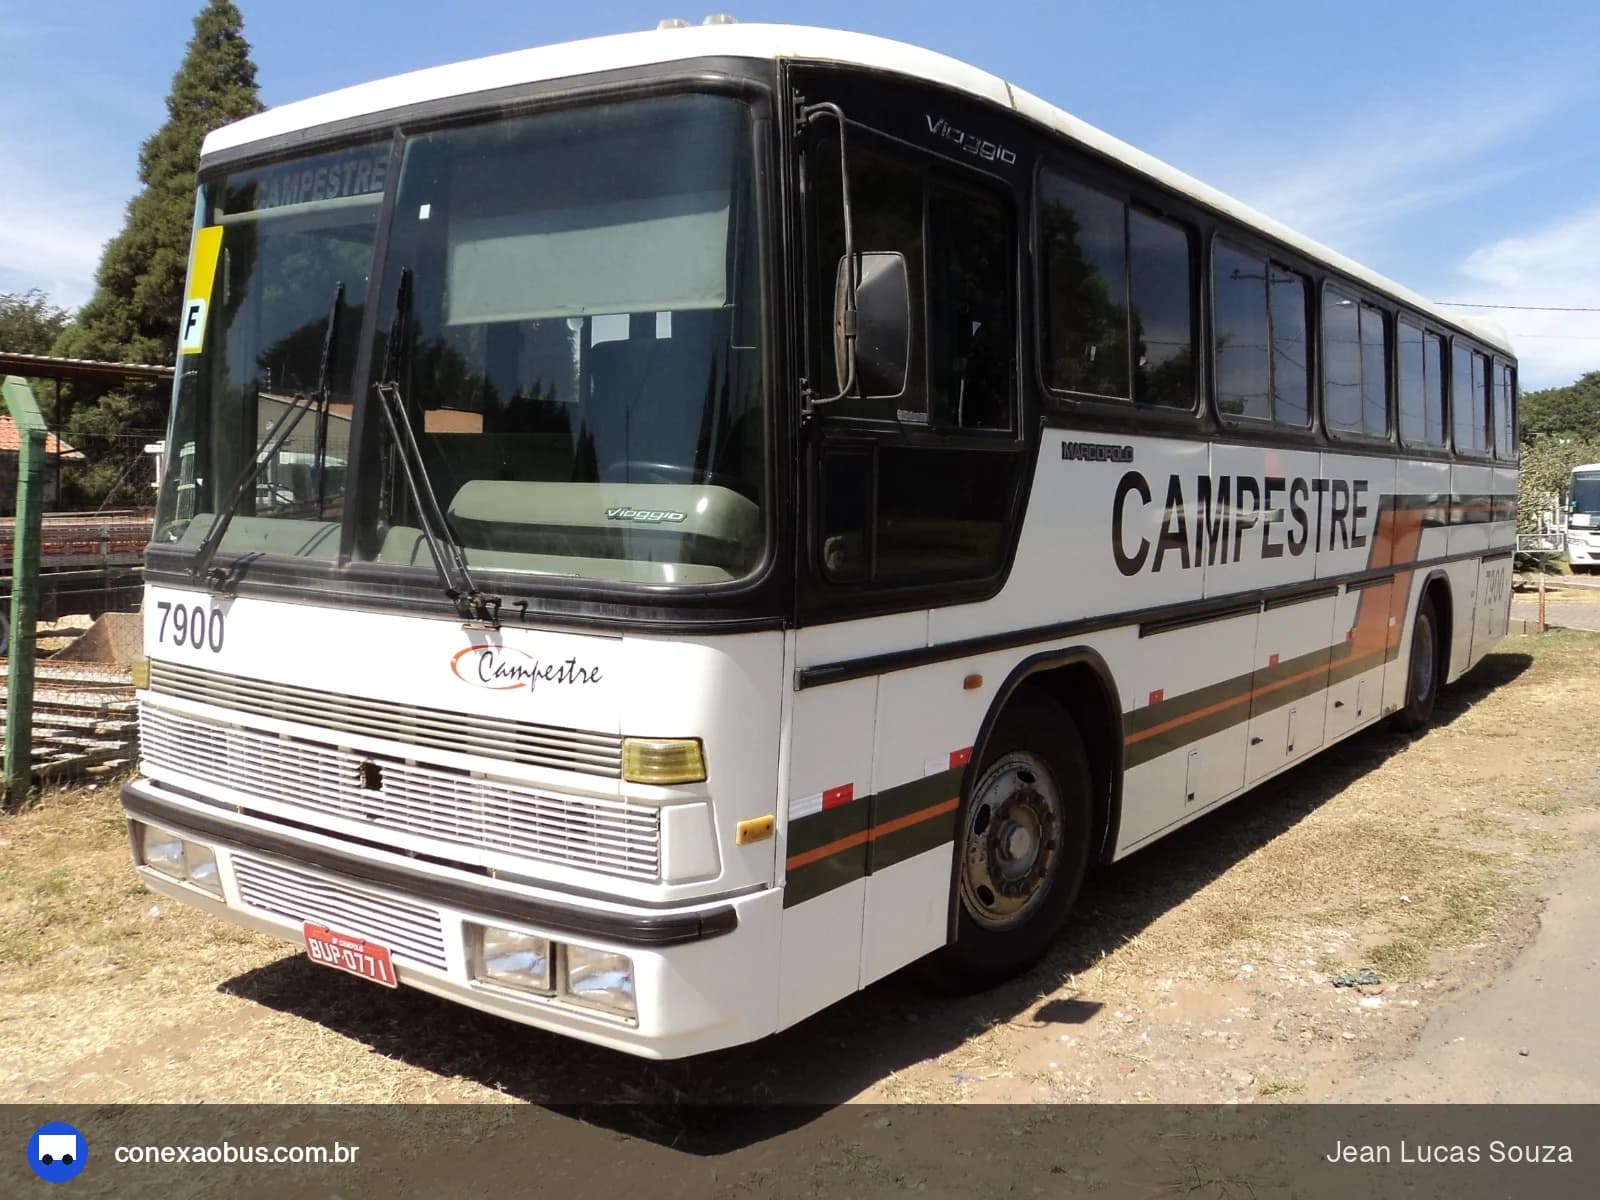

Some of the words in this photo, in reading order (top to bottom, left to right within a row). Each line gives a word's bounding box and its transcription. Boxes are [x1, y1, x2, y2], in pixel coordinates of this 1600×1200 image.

[184, 305, 200, 340] F
[1061, 441, 1134, 463] MARCOPOLO
[605, 506, 685, 522] Viaggio
[1112, 470, 1369, 577] CAMPESTRE
[157, 601, 225, 654] 7900
[478, 650, 604, 693] Campestre
